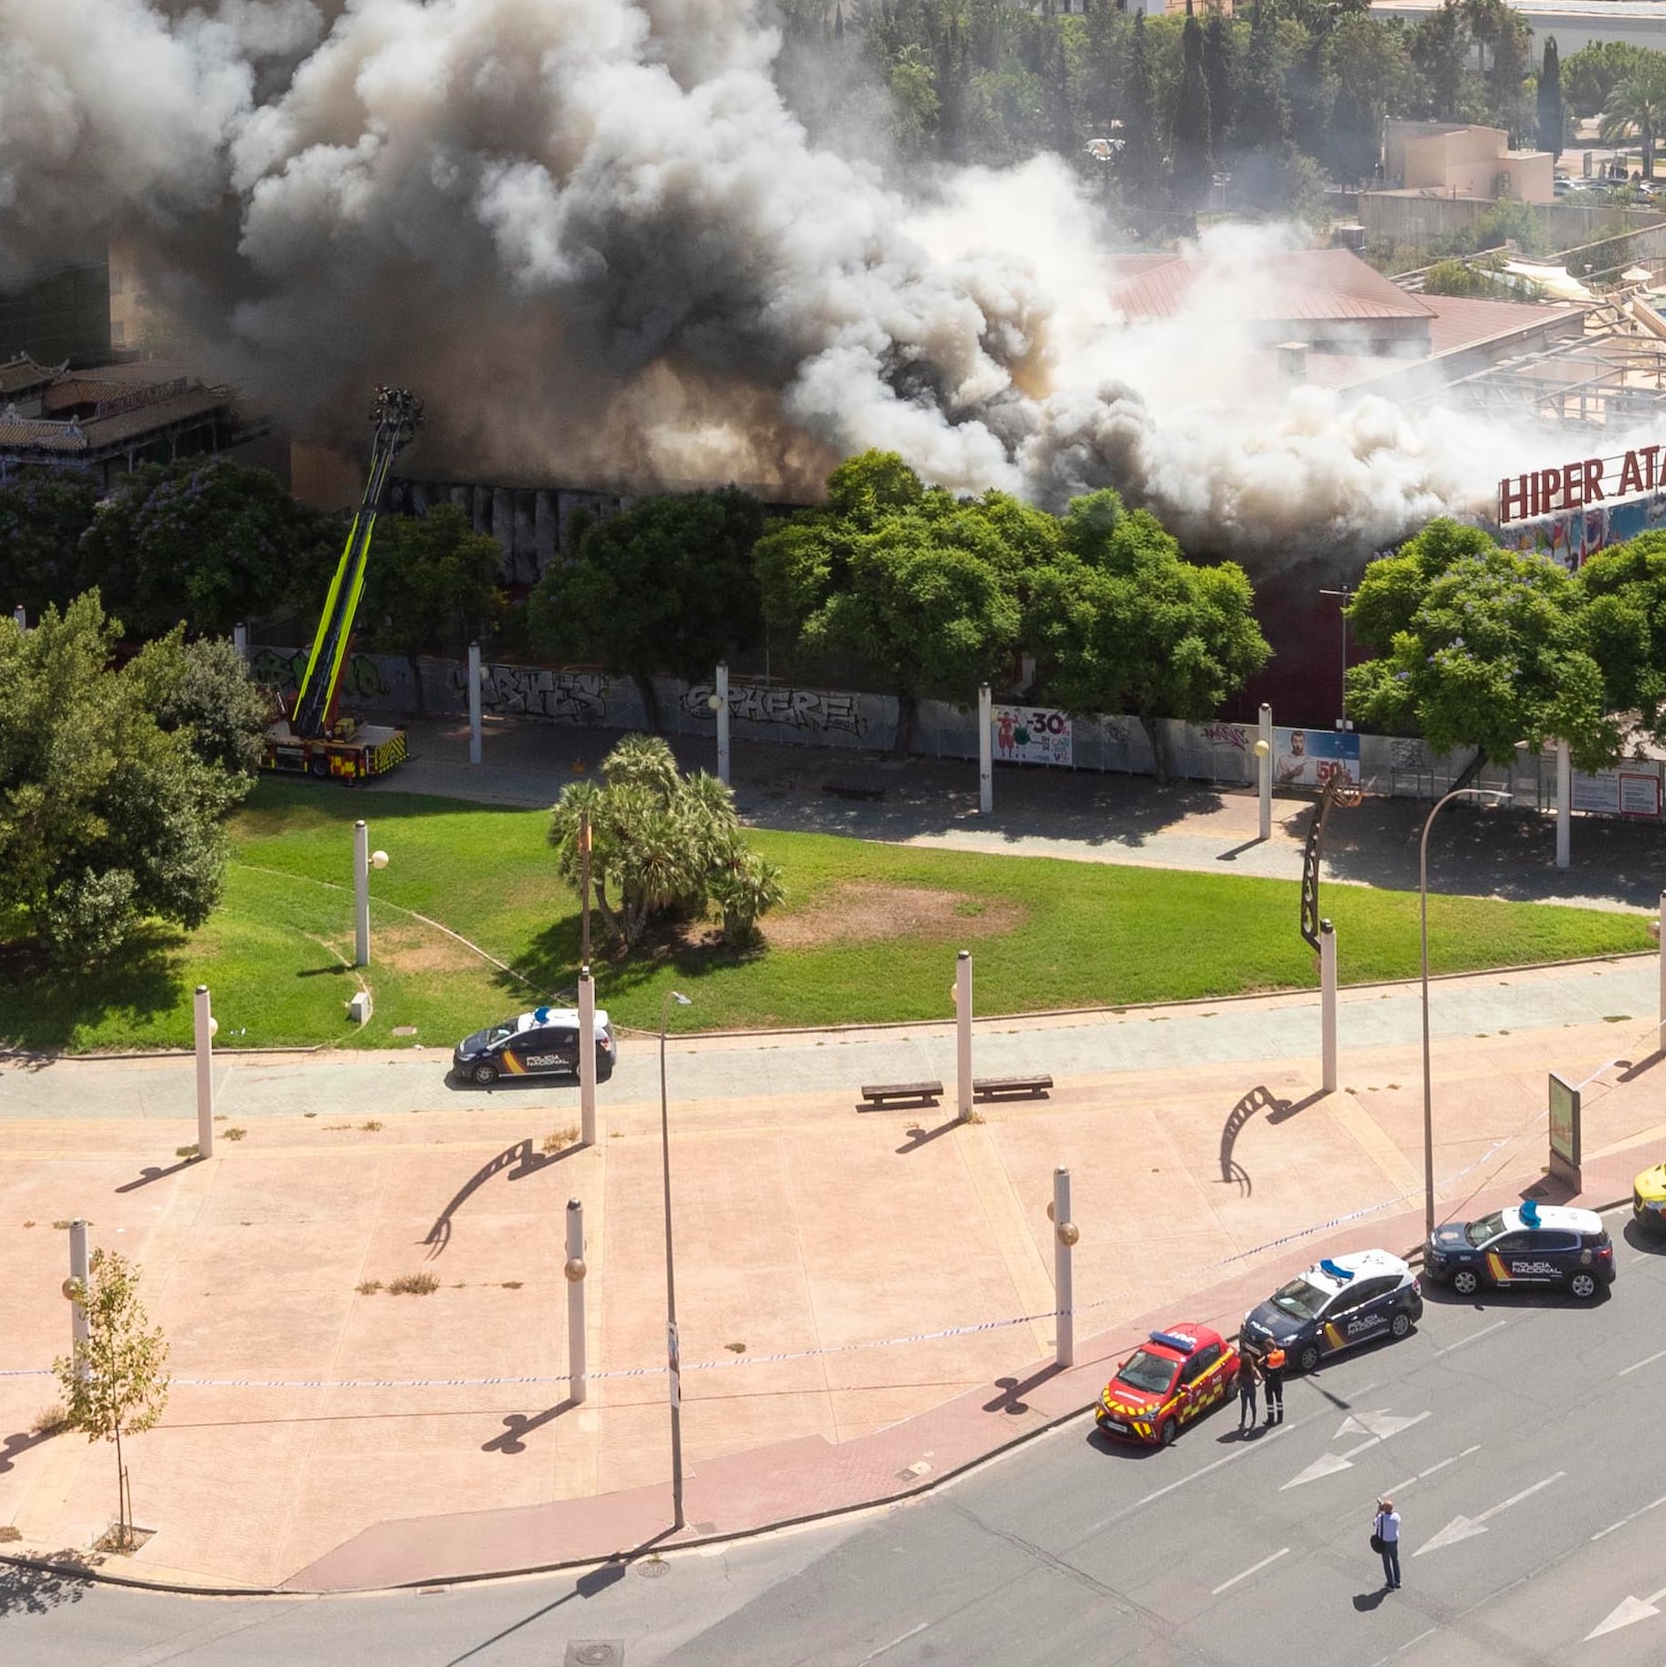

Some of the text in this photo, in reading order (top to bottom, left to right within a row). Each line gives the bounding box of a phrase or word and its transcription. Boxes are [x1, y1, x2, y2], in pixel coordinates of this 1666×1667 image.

[1501, 458, 1605, 524] HIPER
[526, 1054, 559, 1062] POLICIA
[526, 1059, 569, 1067] NACIONAL
[1512, 1261, 1552, 1269] POLICIA
[1512, 1266, 1563, 1275] NACIONAL
